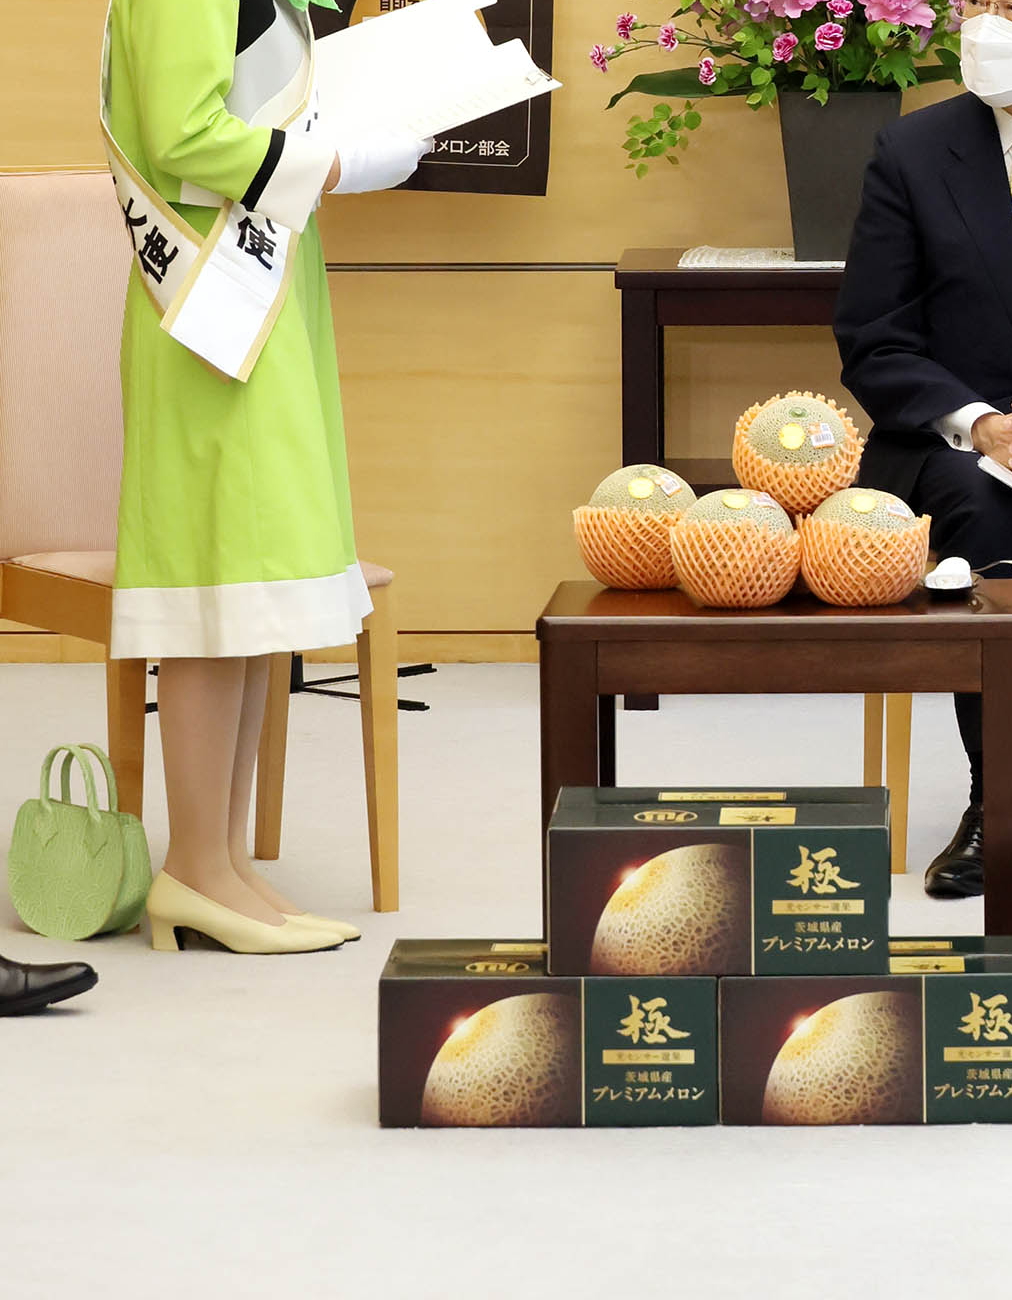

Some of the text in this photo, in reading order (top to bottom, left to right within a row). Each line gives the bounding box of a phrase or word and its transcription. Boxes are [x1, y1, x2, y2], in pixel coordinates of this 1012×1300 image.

[785, 845, 861, 894] 極
[762, 936, 875, 952] プレミアムメロン
[615, 994, 691, 1044] 極
[592, 1086, 705, 1102] プレミアムメロン
